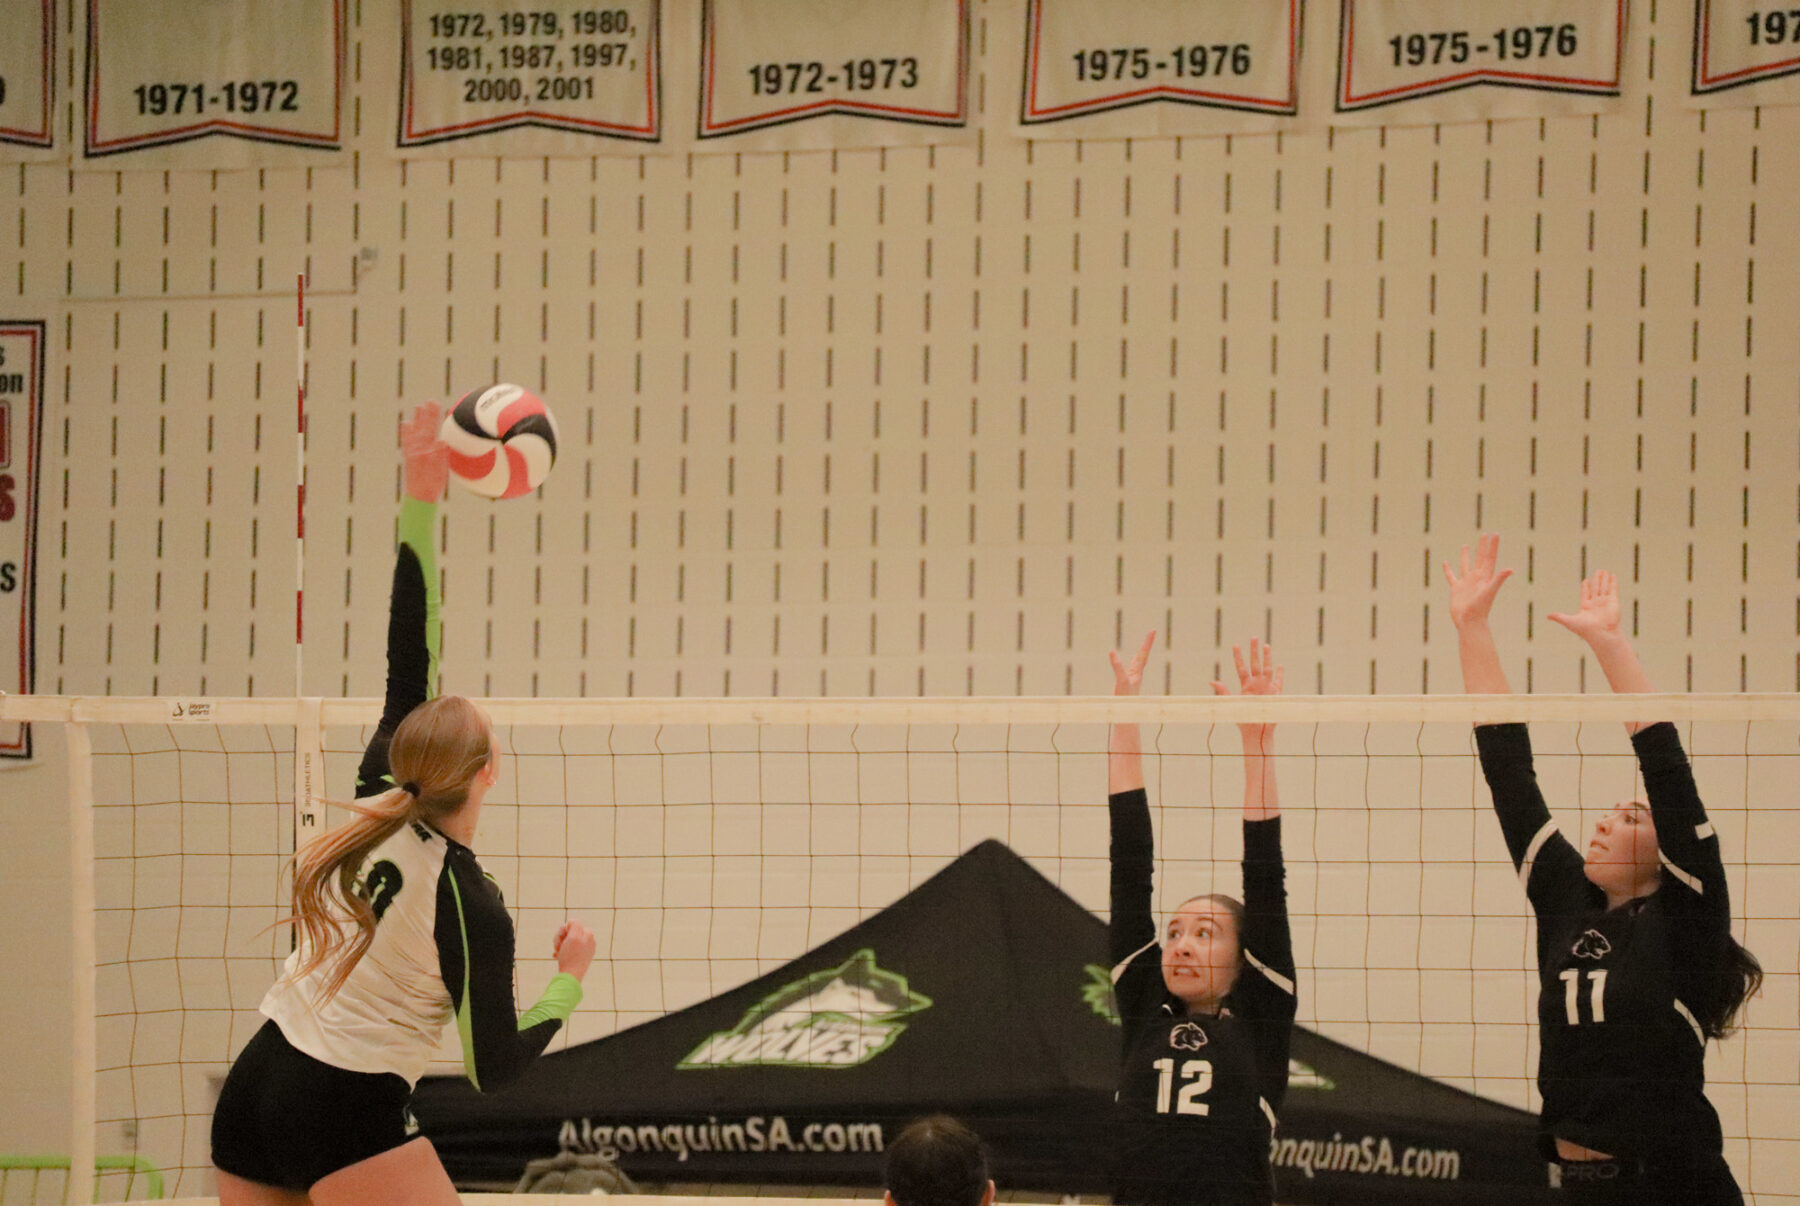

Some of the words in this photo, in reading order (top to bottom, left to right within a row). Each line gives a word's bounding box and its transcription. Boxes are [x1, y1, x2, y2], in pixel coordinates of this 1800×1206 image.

[429, 13, 493, 41] 1972,
[499, 12, 564, 40] 1979,
[571, 10, 636, 38] 1980,
[428, 46, 492, 74] 1981,
[499, 45, 563, 73] 1987,
[571, 43, 636, 71] 1997,
[1073, 44, 1250, 81] 1975-1976
[1389, 24, 1577, 66] 1975-1976
[464, 78, 530, 106] 2000,
[536, 76, 594, 100] 2001
[749, 57, 918, 94] 1972-1973
[134, 80, 298, 116] 1971-1972
[1559, 968, 1608, 1025] 11
[1153, 1057, 1213, 1116] 12
[558, 1115, 884, 1161] AlgonquinSA.com
